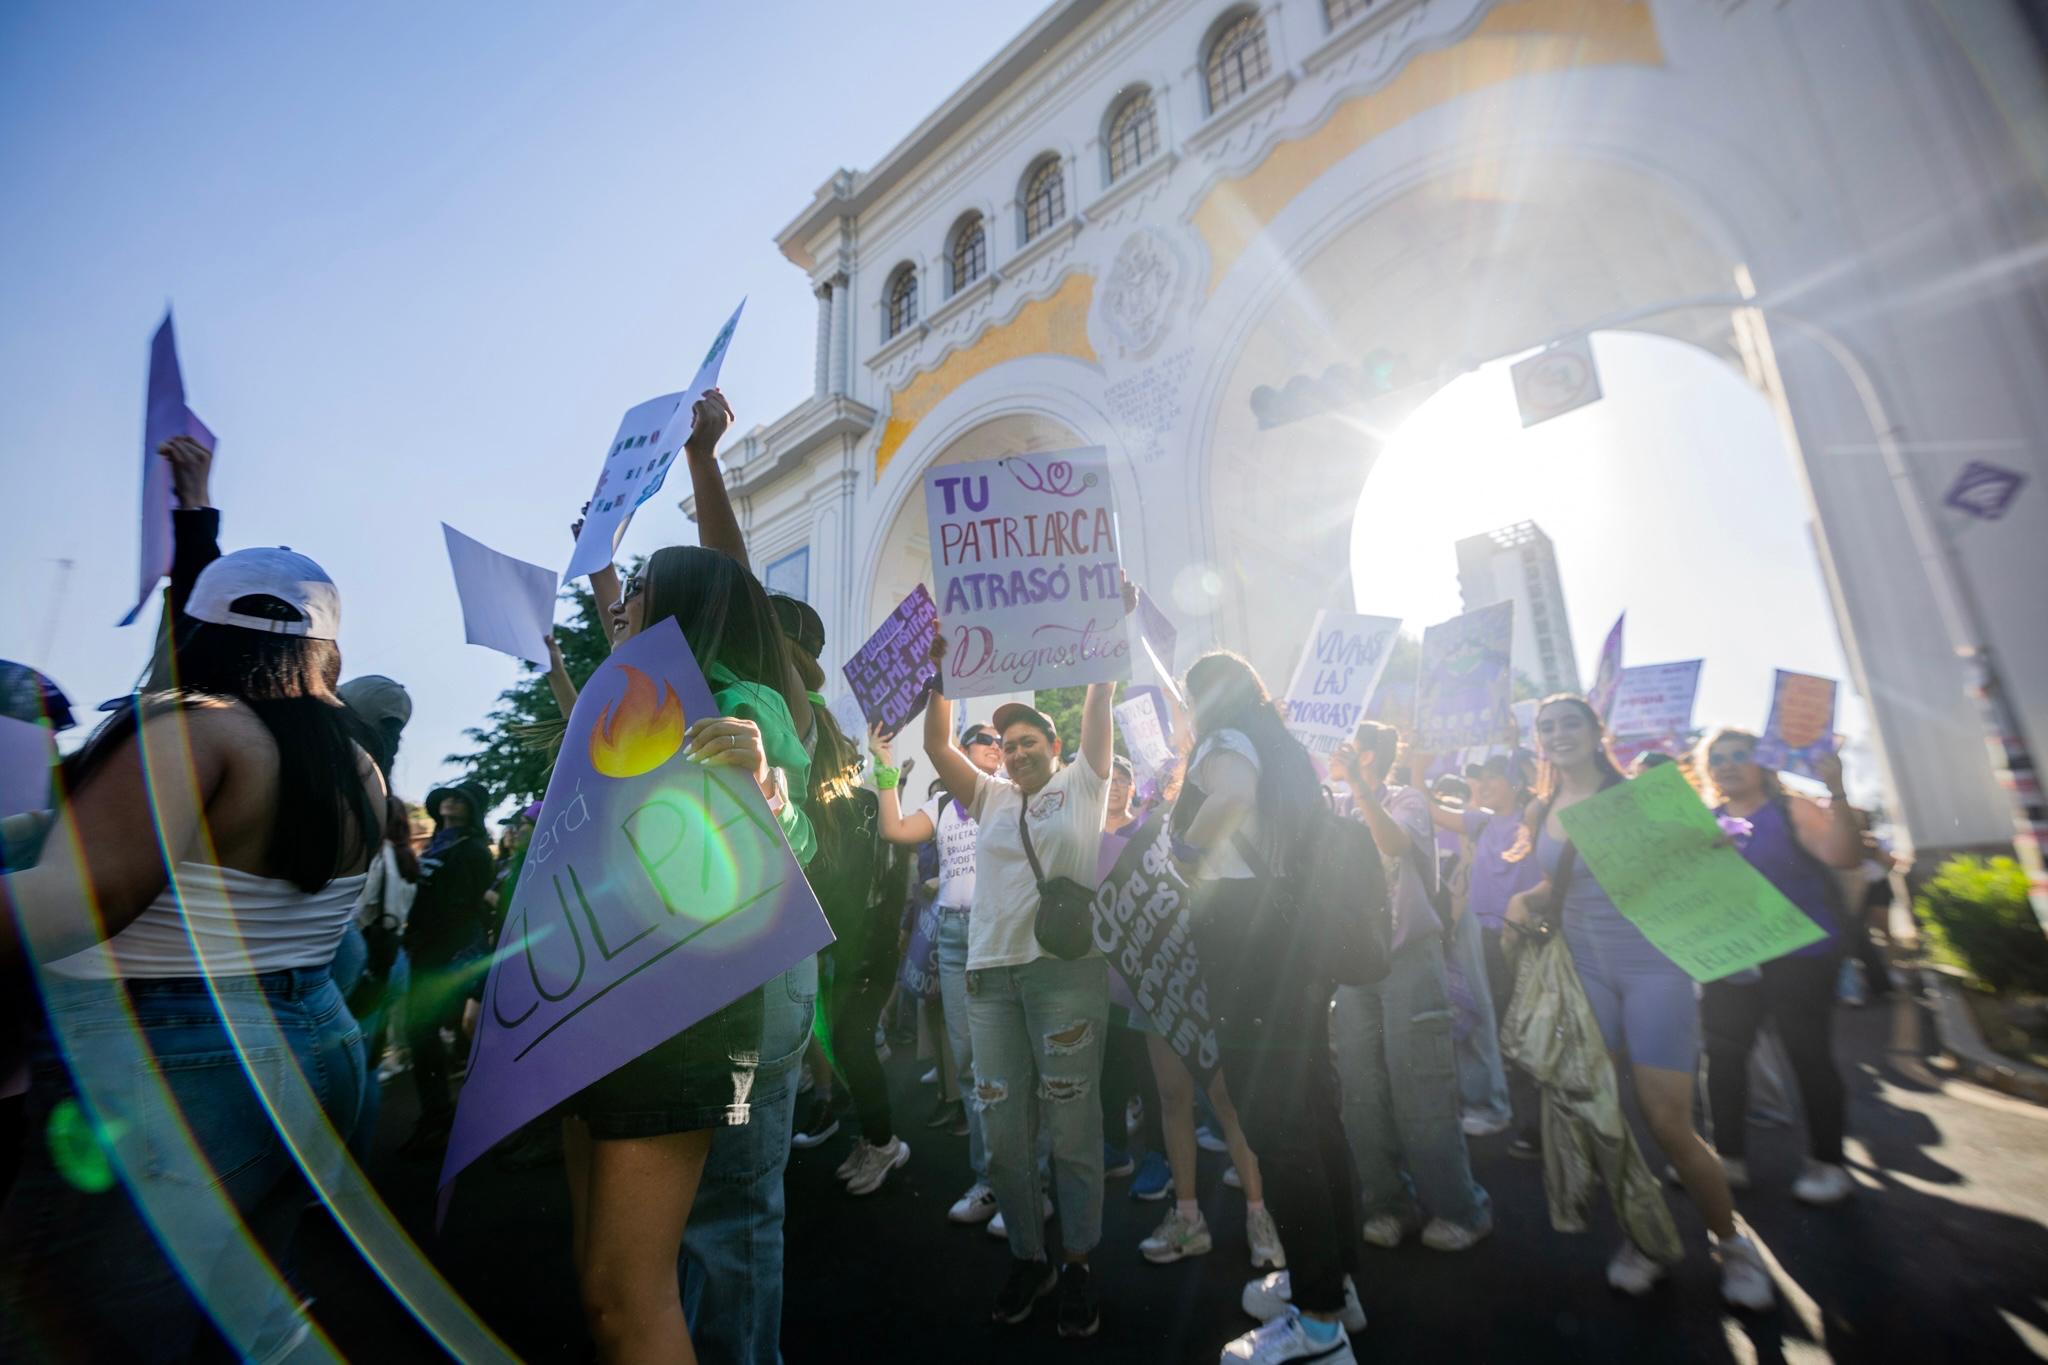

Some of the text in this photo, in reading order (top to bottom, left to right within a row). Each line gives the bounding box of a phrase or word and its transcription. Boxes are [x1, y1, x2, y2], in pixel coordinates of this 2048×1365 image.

[935, 475, 989, 515] TU
[940, 507, 1114, 566] PATRIARCA
[900, 590, 924, 618] QUE
[944, 561, 1120, 616] ATRASÓ MI
[863, 666, 878, 681] EL
[875, 651, 890, 670] LO
[952, 618, 1129, 685] Diagnostico
[886, 657, 912, 688] ME
[1312, 668, 1354, 696] LAS
[1286, 699, 1362, 734] MORRAS!
[521, 777, 589, 882] será
[493, 768, 781, 1029] CULPA
[1172, 1017, 1199, 1056] un
